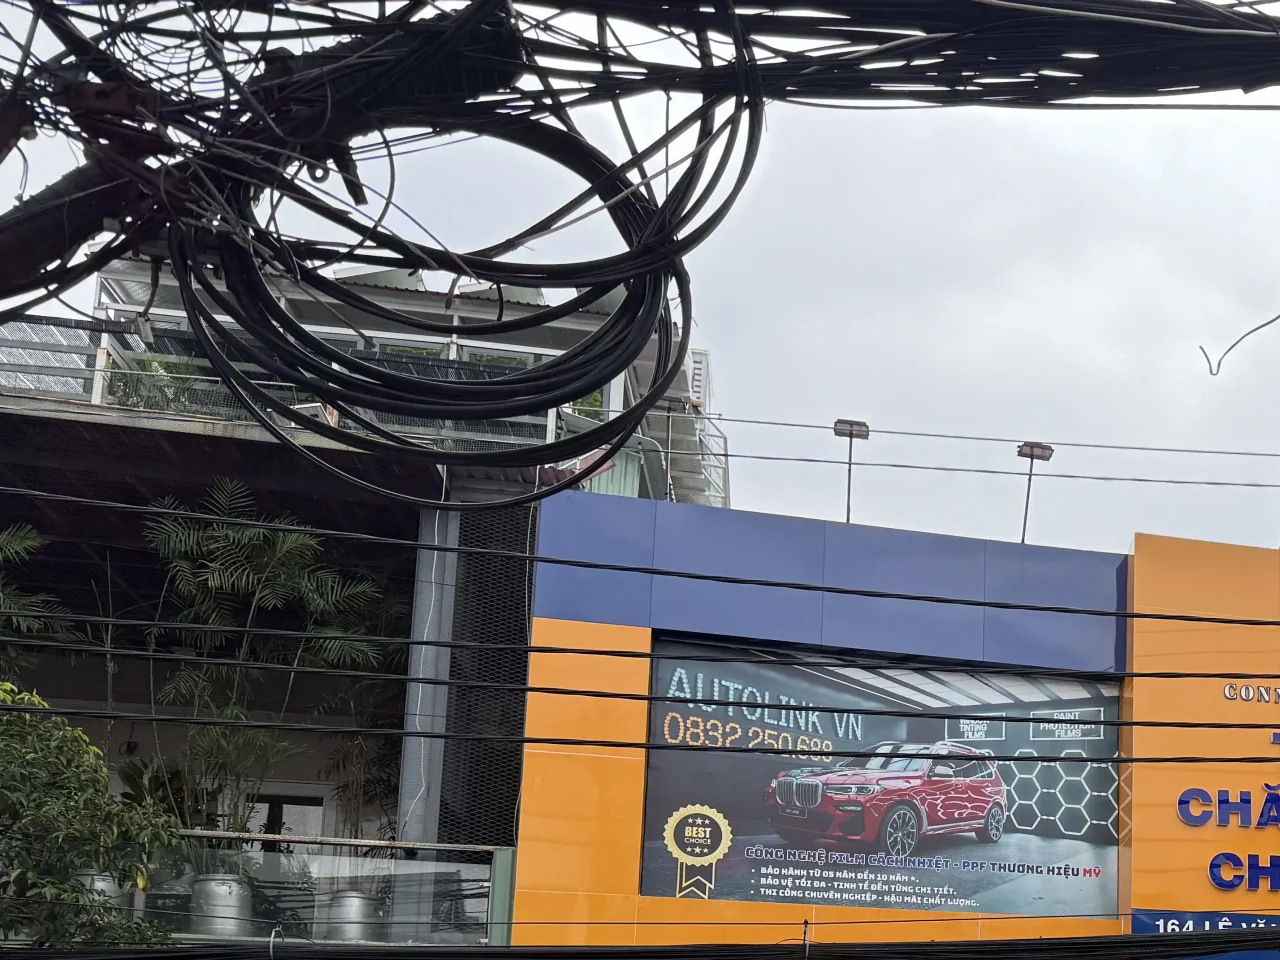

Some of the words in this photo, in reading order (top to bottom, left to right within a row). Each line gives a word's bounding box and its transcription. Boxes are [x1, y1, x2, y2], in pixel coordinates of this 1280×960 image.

[666, 667, 823, 735] AUTOLINK
[834, 711, 862, 741] VN
[959, 724, 988, 732] TINTING
[964, 731, 986, 739] FILMS
[1055, 729, 1082, 738] FILMS
[664, 711, 833, 763] 0832250.688
[684, 826, 712, 838] BEST
[684, 837, 712, 845] CHOICE
[744, 845, 784, 861] CÔNG
[786, 848, 827, 865] NGHỆ
[828, 852, 866, 866] FILM
[906, 857, 952, 872] NHIỆT
[961, 860, 988, 872] PPF
[989, 861, 1044, 875] THƯƠNG
[1046, 863, 1080, 879] HIỆU
[1082, 865, 1102, 878] MỸ
[760, 864, 780, 875] BẢO
[781, 866, 807, 877] HÀNH
[836, 870, 856, 880] NĂM
[876, 873, 888, 881] 10
[889, 872, 909, 882] NĂM
[760, 876, 780, 886] BẢO
[781, 877, 793, 888] VỆ
[794, 877, 812, 887] TỐI
[833, 881, 857, 890] TINH
[915, 886, 932, 895] CHI
[759, 888, 778, 896] THI
[779, 887, 804, 898] CÔNG
[804, 889, 841, 900] CHUYÊN
[842, 891, 878, 903] NGHIỆP
[883, 893, 903, 905] HẬU
[923, 894, 946, 906] CHẤT
[1155, 918, 1194, 933] 164
